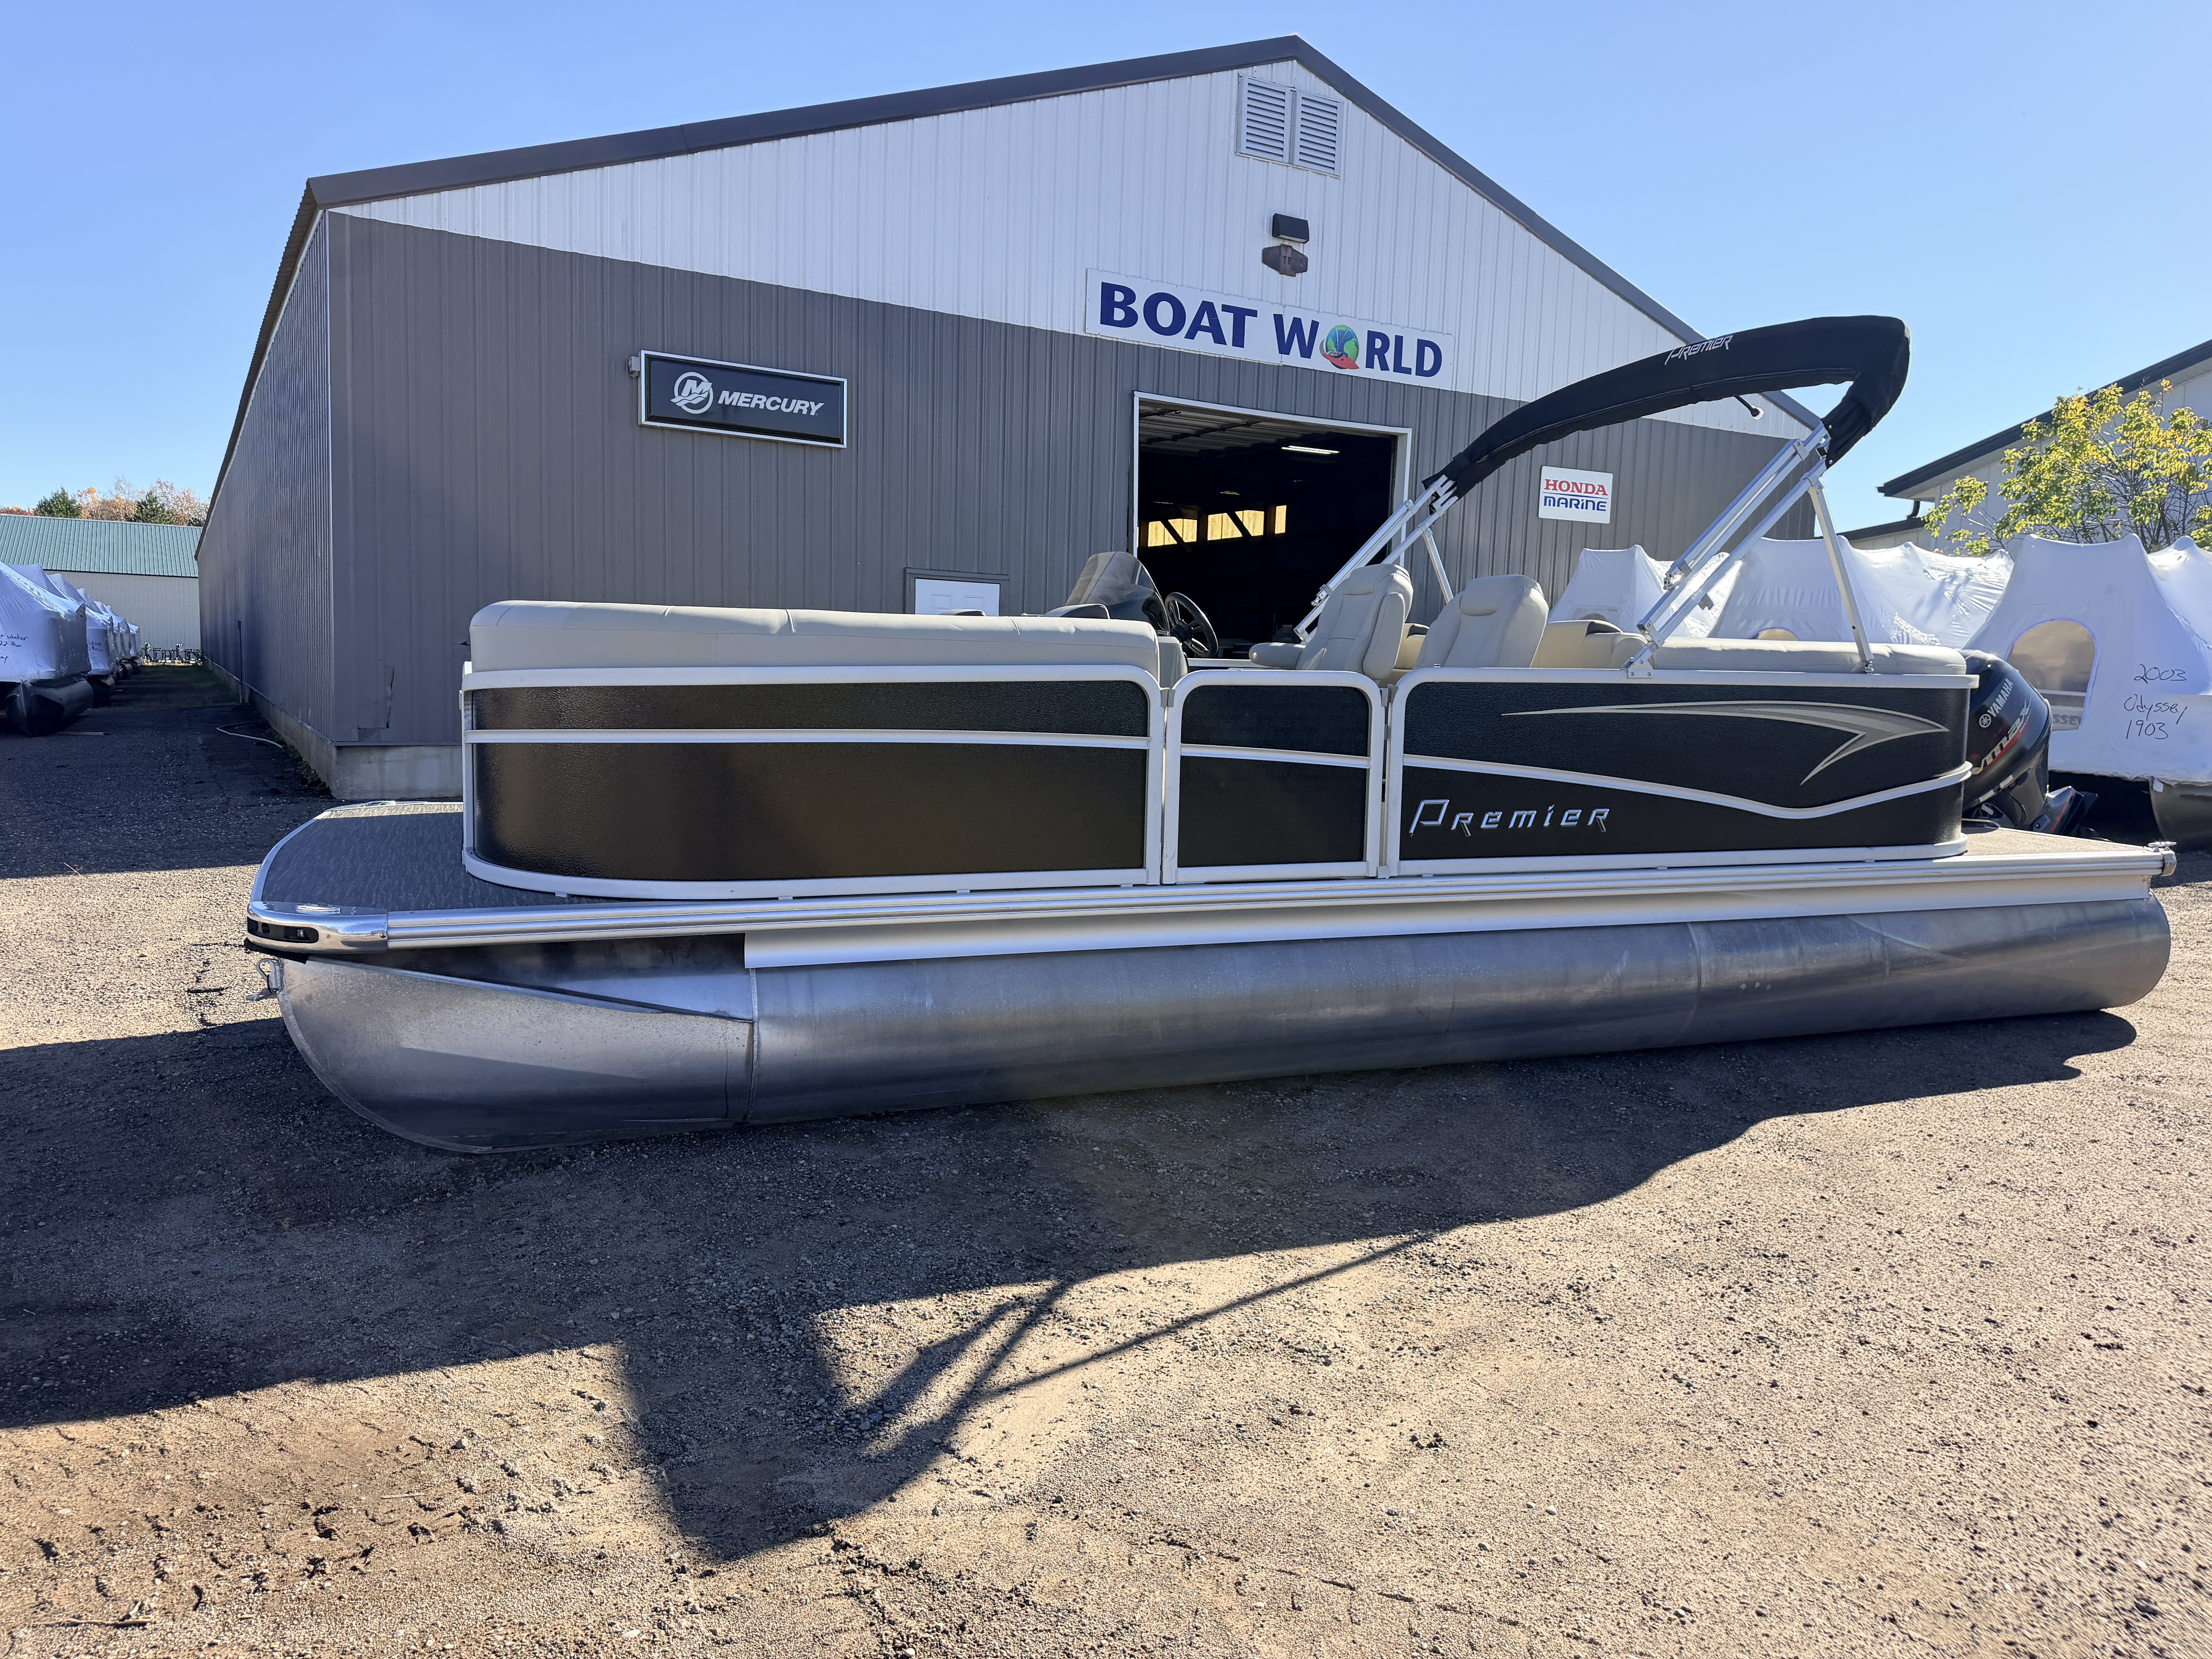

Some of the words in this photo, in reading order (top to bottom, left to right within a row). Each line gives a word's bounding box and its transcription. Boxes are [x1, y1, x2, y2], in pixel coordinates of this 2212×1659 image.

[1099, 281, 1258, 348] BOAT
[717, 390, 825, 416] MERCURY
[1544, 479, 1608, 496] HONDA
[2134, 664, 2187, 685] 2003
[1987, 678, 2014, 718] YAMAHA
[2124, 694, 2188, 725] Odyssey
[2126, 720, 2168, 740] 1903
